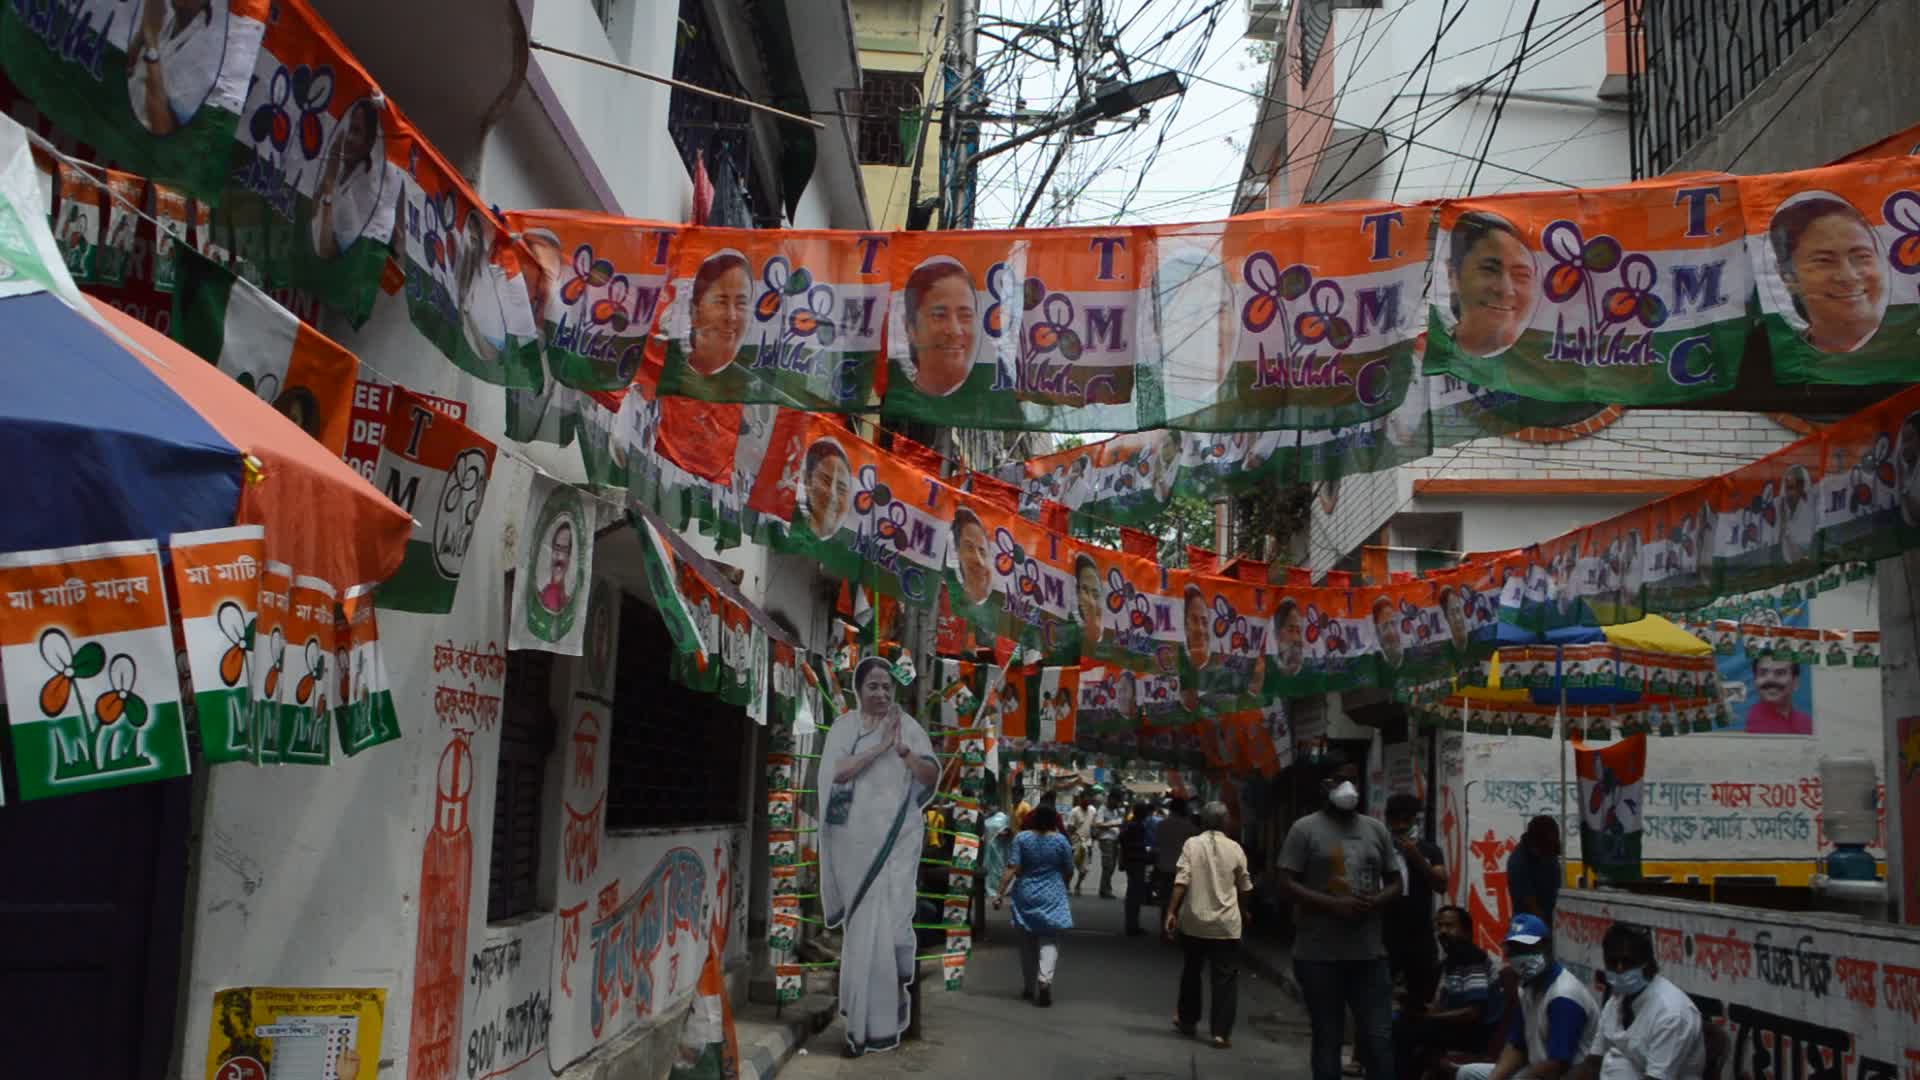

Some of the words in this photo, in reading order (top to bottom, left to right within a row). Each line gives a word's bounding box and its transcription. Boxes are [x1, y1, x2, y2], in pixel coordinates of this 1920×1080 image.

[1673, 184, 1720, 238] T.
[1088, 237, 1125, 280] T.
[1360, 211, 1405, 262] T.
[1352, 281, 1404, 338] M.
[1667, 260, 1728, 314] M.
[1082, 306, 1127, 350] M.
[7, 590, 34, 612] মা
[40, 578, 87, 608] মাটি
[92, 575, 150, 604] মানুষ
[185, 566, 210, 586] মা
[215, 555, 258, 584] মাটি
